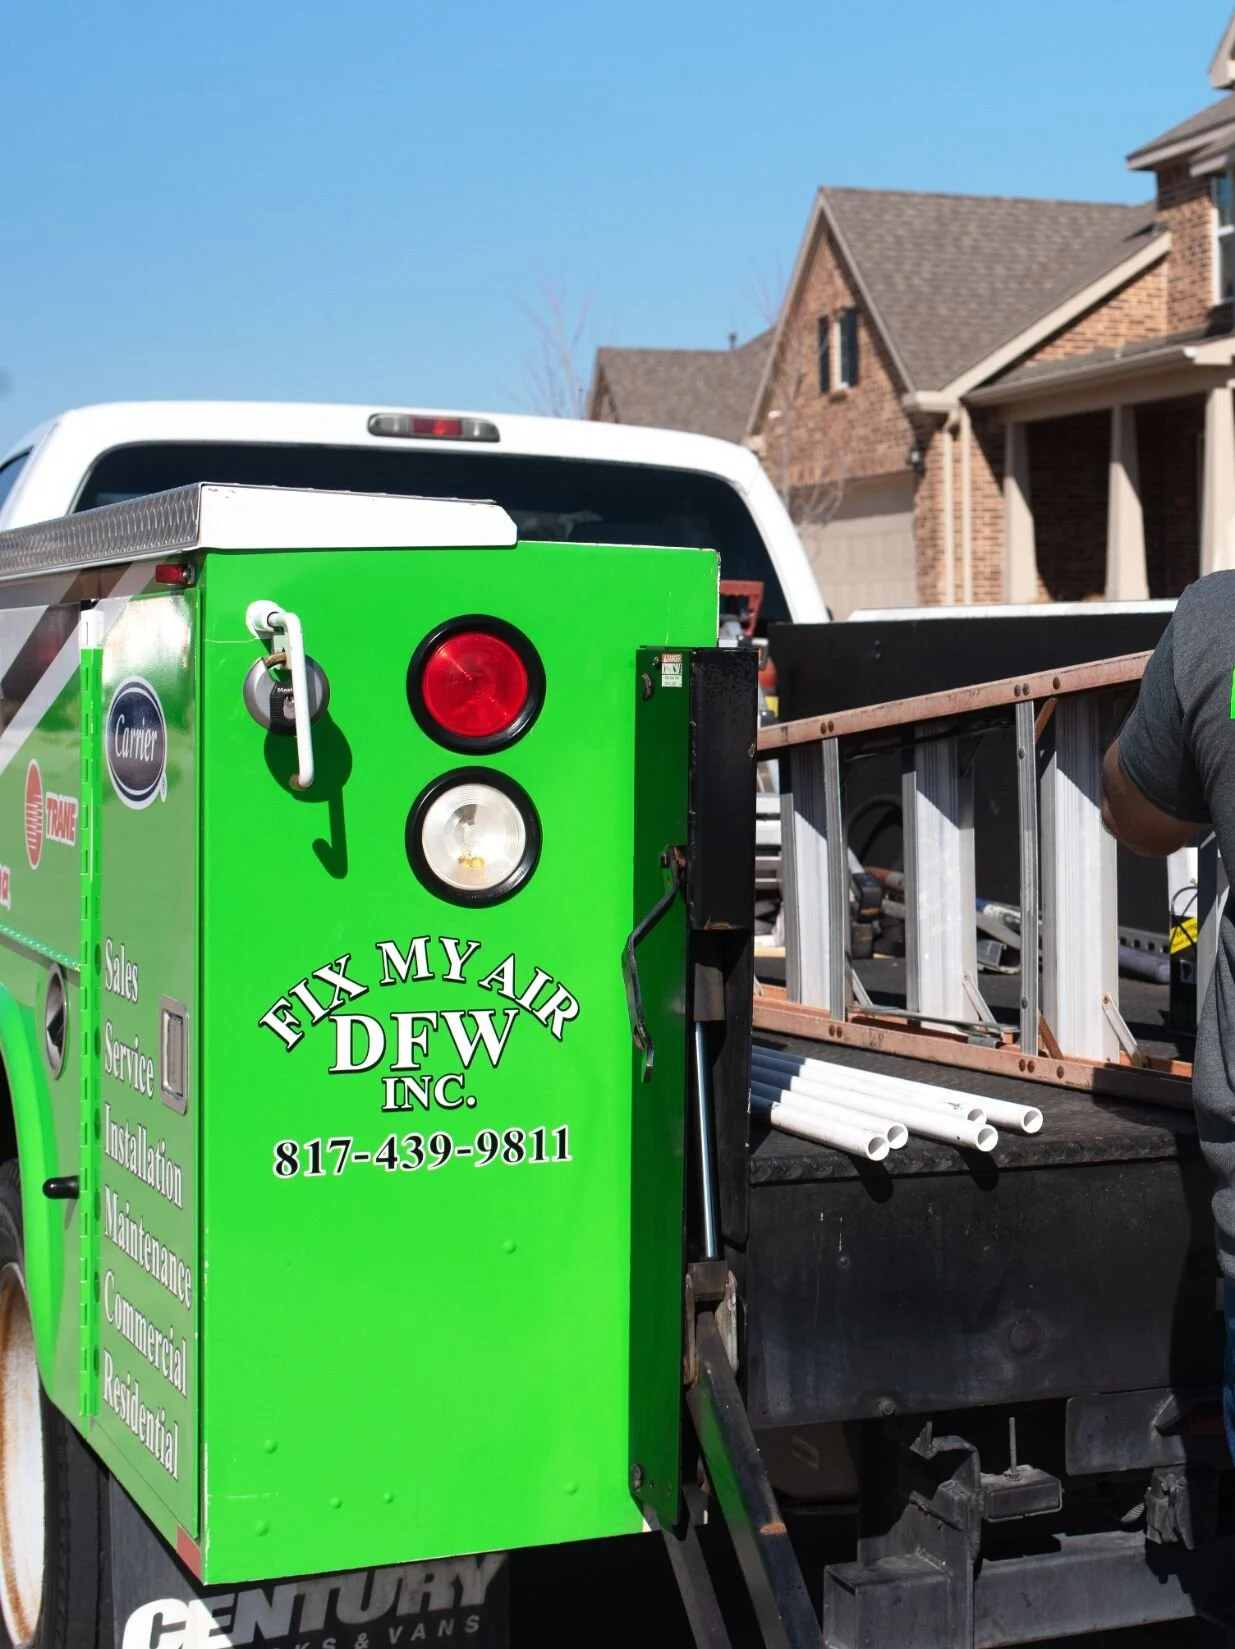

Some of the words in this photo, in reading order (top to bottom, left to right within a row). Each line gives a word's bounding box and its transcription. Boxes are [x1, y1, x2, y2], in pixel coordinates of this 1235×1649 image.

[114, 714, 158, 762] Carrier
[46, 795, 77, 845] TRANE
[104, 936, 139, 1004] Sales
[258, 952, 369, 1051] FIX
[376, 935, 481, 987] MY
[478, 952, 581, 1041] AIR
[104, 1018, 154, 1100] Service
[328, 1008, 520, 1074] DFW
[381, 1073, 477, 1112] INC.
[104, 1101, 183, 1210] Installation
[273, 1124, 573, 1178] 817-439-9811
[104, 1184, 193, 1312] Maintenance
[104, 1268, 187, 1399] Commercial
[103, 1348, 180, 1482] Residential
[121, 1553, 509, 1649] CENTURY
[388, 1615, 481, 1646] VANS
